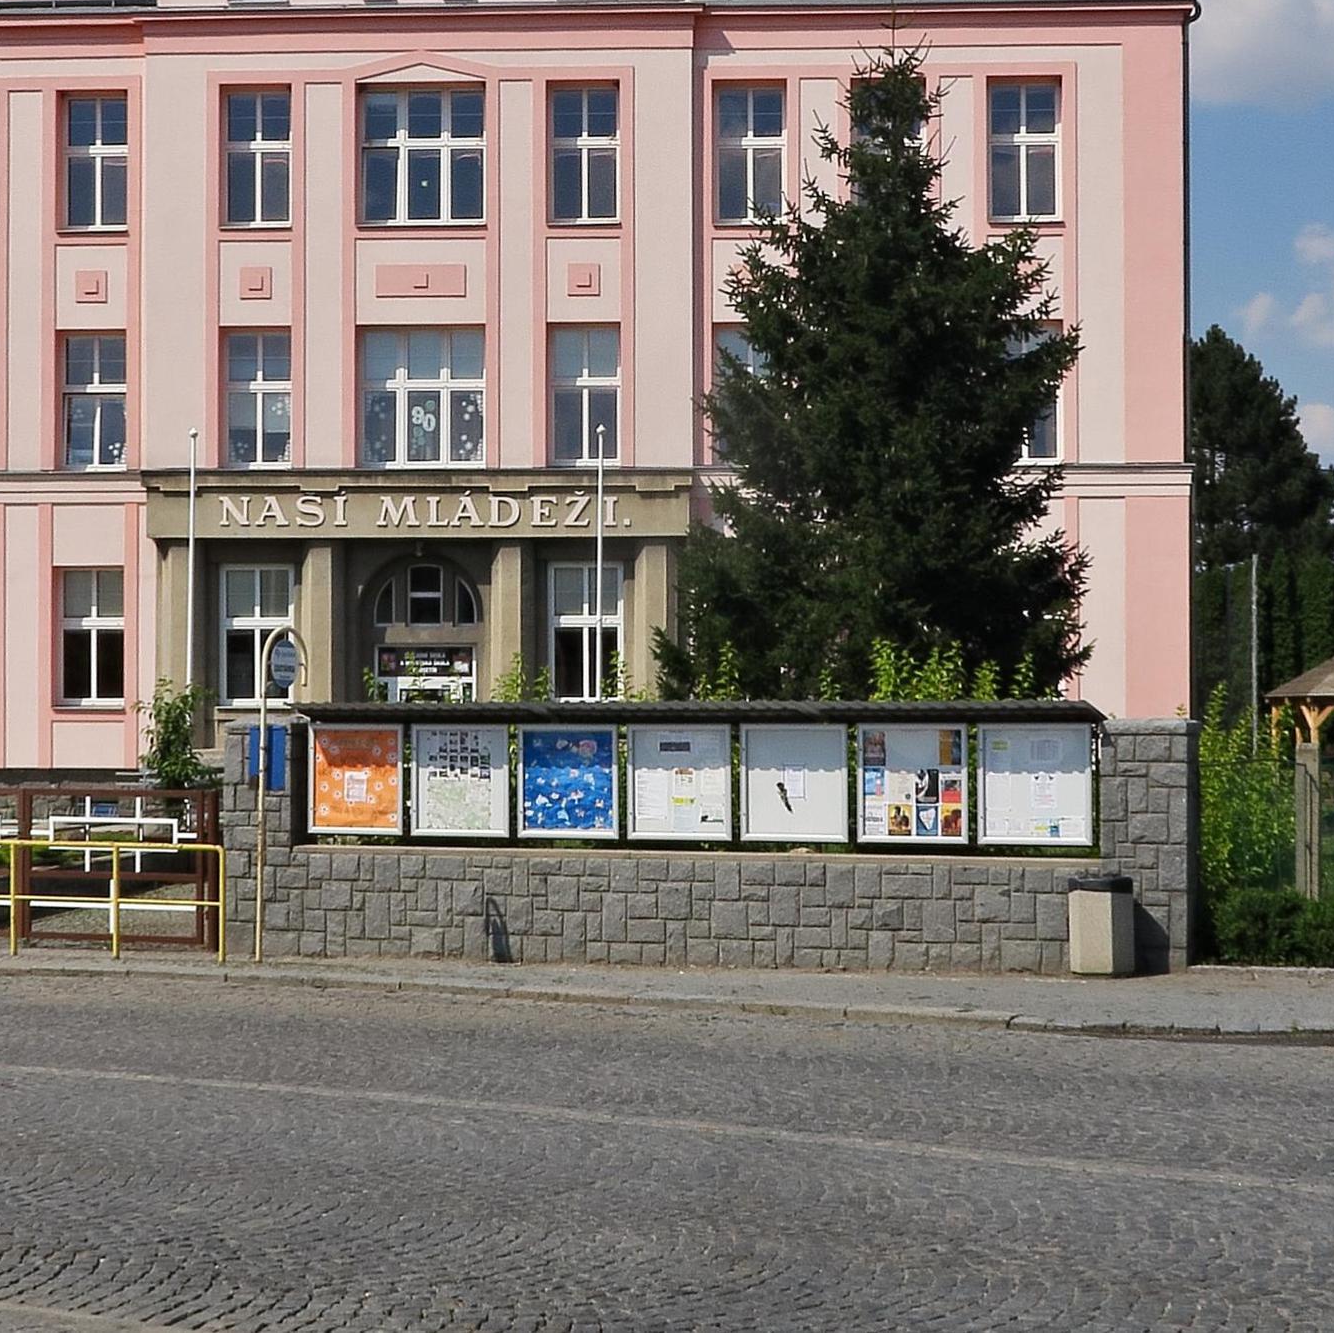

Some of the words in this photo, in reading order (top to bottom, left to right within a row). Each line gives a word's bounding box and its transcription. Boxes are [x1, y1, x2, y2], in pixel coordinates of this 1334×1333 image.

[411, 406, 436, 432] 90
[219, 490, 349, 527] NAŠÍ
[376, 490, 632, 527] MLÁDEŽI.
